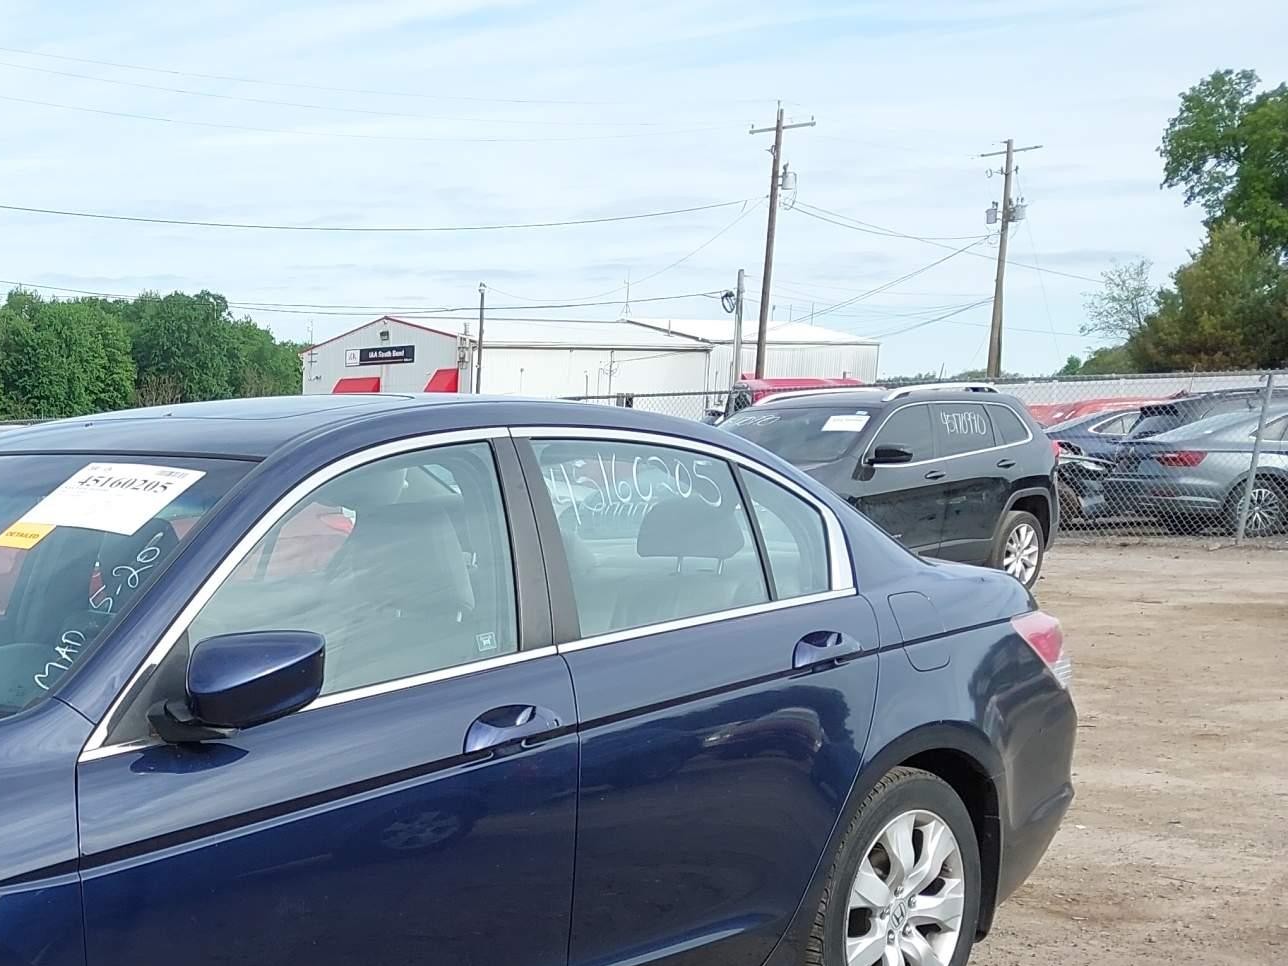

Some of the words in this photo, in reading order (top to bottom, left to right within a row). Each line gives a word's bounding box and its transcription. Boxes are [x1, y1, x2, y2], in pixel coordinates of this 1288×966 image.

[77, 474, 176, 494] 45160205
[5, 530, 40, 540] DETAILED
[34, 629, 87, 691] MAD
[89, 534, 163, 614] 5-20
